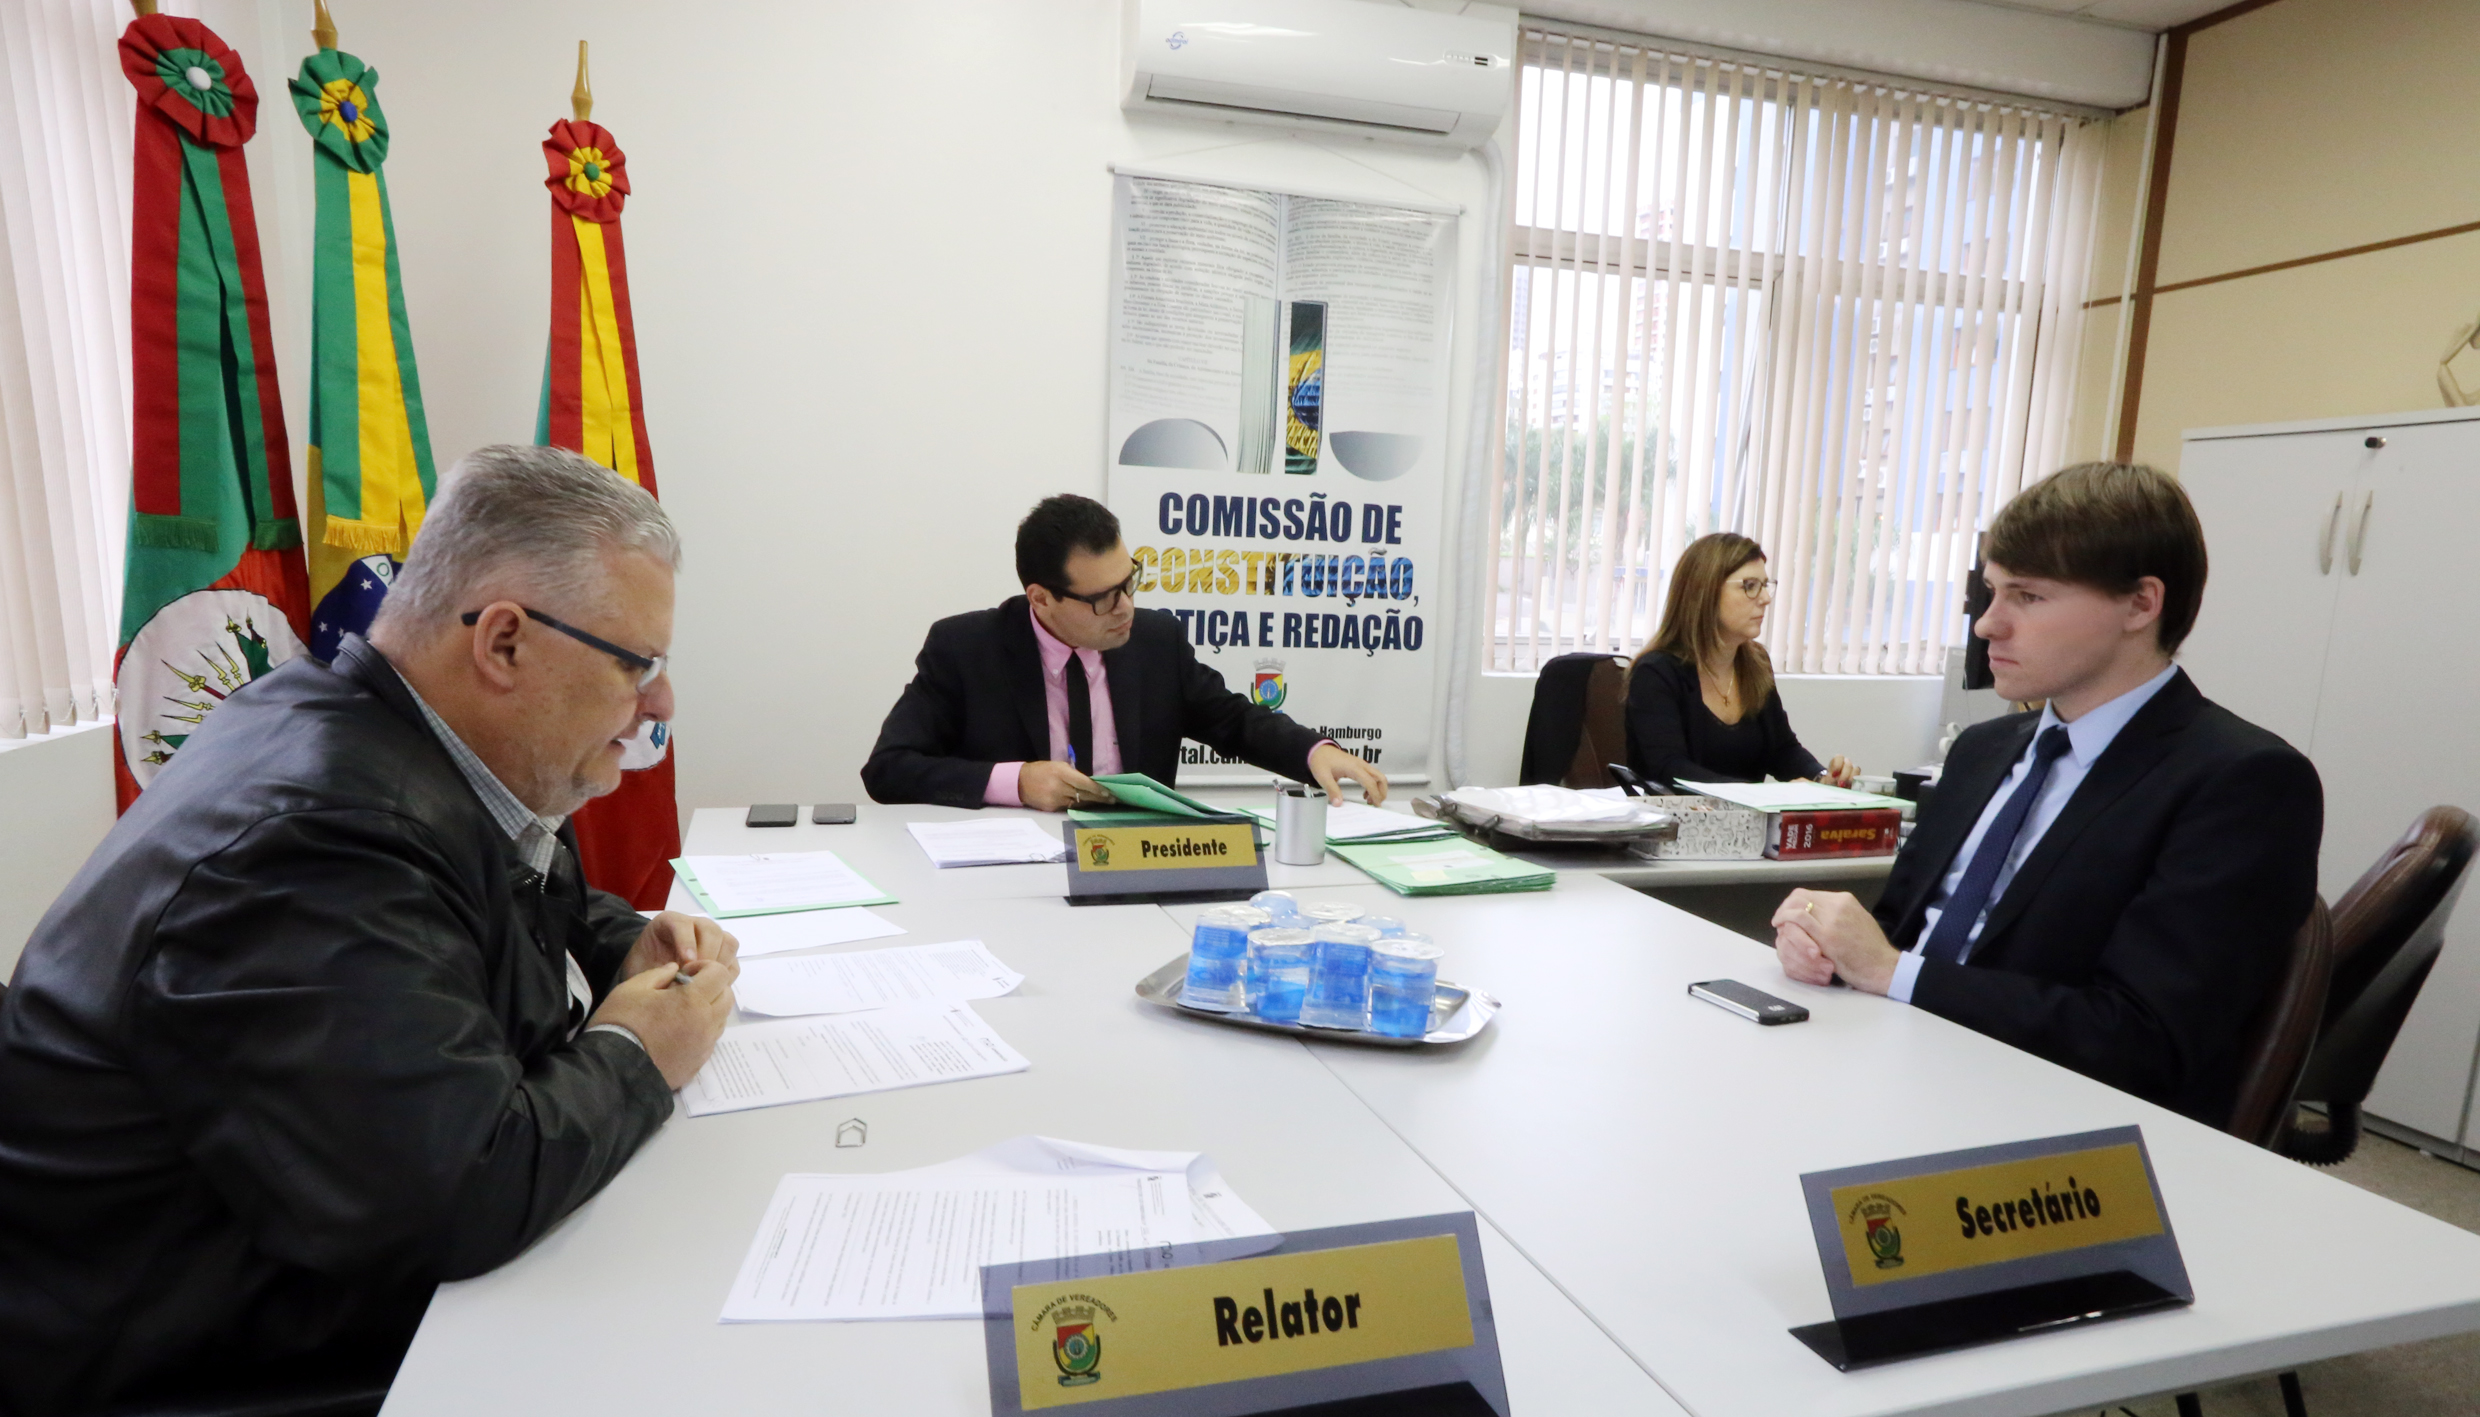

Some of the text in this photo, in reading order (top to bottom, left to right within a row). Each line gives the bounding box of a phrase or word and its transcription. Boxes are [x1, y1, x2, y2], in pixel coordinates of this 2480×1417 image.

[1158, 491, 1403, 544] COMISSÃO DE
[1133, 546, 1419, 607] CONSTITUIÇÃO,
[1258, 611, 1275, 647] E
[1282, 608, 1424, 657] REDAÇÃO
[1320, 725, 1382, 741] Hamburgo
[1141, 837, 1228, 858] Presidente
[1785, 824, 1794, 850] VADE
[1803, 823, 1814, 849] 2016
[1820, 829, 1876, 842] Saraiva
[1956, 1175, 2101, 1239] Secretário
[1056, 1295, 1068, 1305] DE
[1213, 1288, 1361, 1347] Relator
